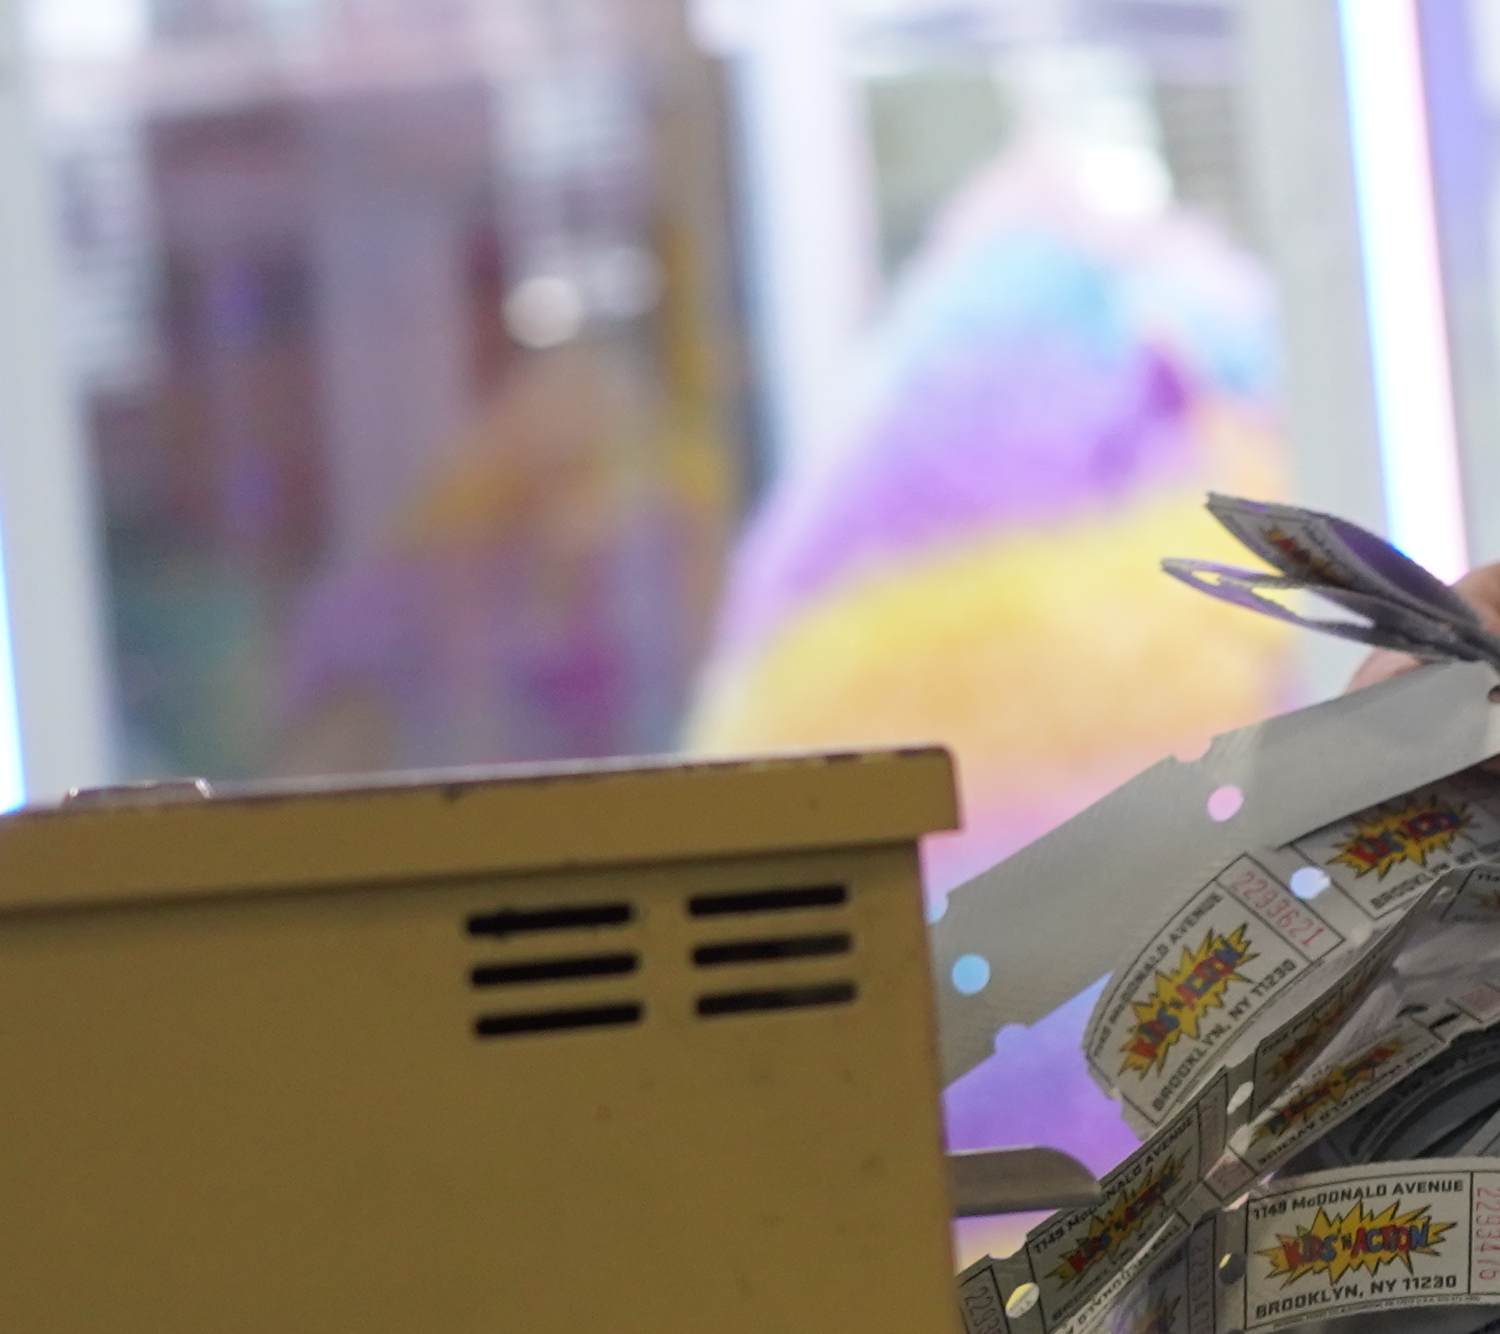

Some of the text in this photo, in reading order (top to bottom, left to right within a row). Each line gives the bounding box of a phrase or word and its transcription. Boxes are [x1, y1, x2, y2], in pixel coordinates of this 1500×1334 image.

[1231, 870, 1324, 947] 2293621
[1229, 998, 1250, 1018] NY
[1254, 1178, 1464, 1221] 1149 McDONALD AVENUE
[1282, 1215, 1431, 1270] KIDS ACTION
[1255, 1282, 1364, 1319] BROOKLYN,
[1370, 1280, 1398, 1295] NY
[1402, 1275, 1458, 1291] 11230
